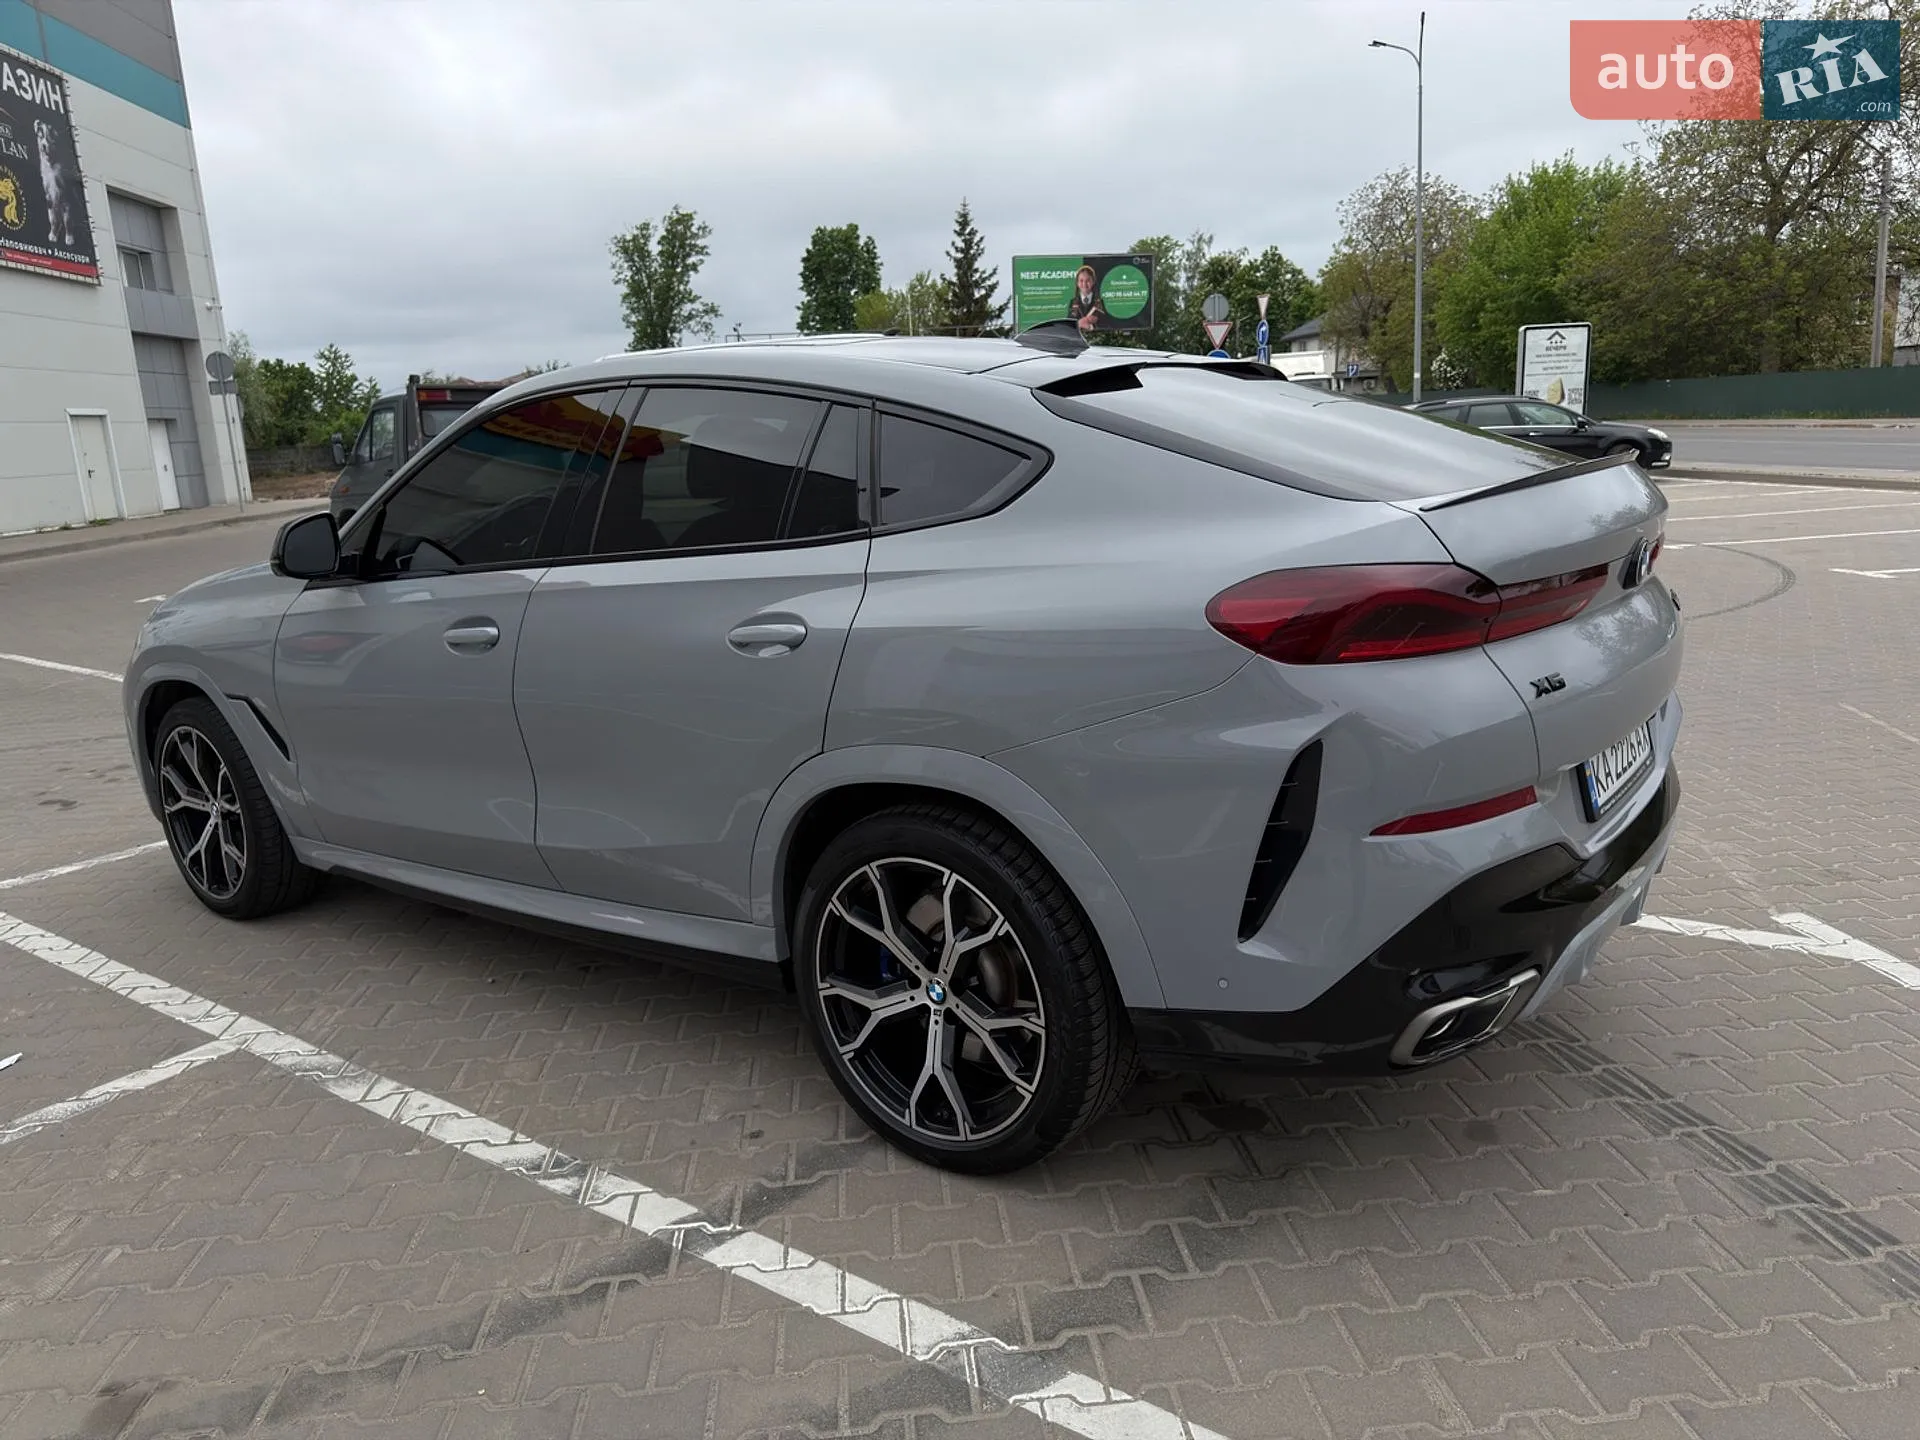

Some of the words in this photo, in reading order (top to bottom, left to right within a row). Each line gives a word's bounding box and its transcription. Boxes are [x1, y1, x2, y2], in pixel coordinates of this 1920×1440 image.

[1, 62, 65, 114] АЗИН
[1020, 271, 1040, 280] NEST
[1040, 270, 1077, 279] ACADEMY
[1530, 672, 1566, 698] X6
[1591, 752, 1614, 798] KA
